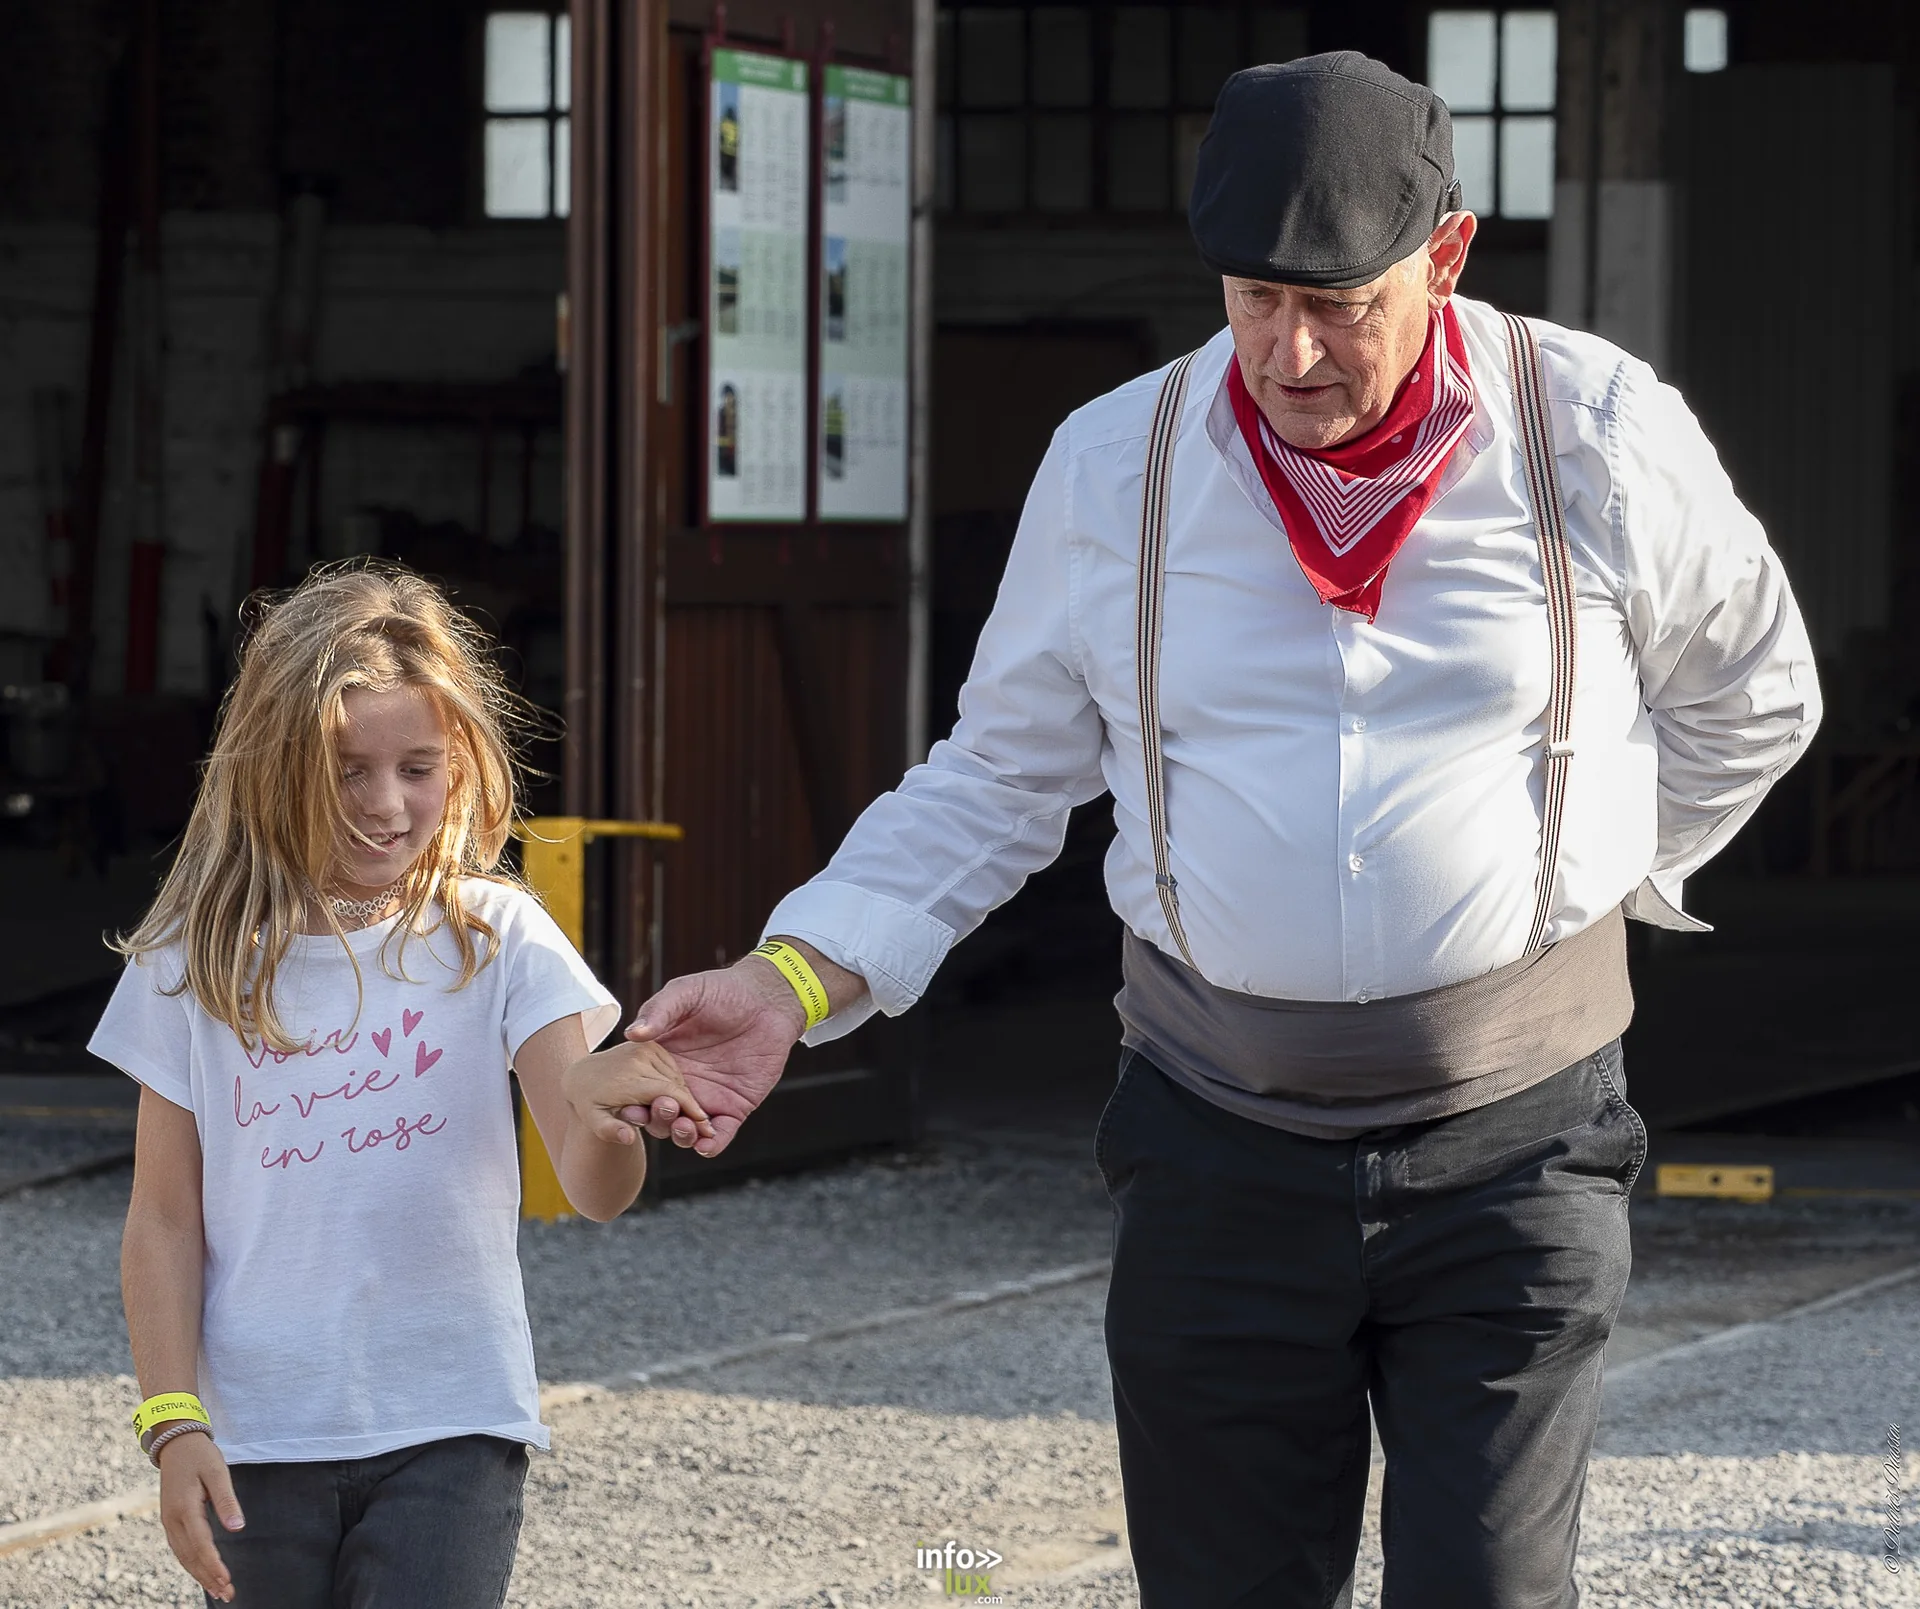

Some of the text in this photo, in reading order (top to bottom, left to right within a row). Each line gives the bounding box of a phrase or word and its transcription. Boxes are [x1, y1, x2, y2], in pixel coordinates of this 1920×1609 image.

[234, 1070, 400, 1127] la vie
[261, 1113, 448, 1169] en rose
[150, 1402, 189, 1415] FESTIVAL
